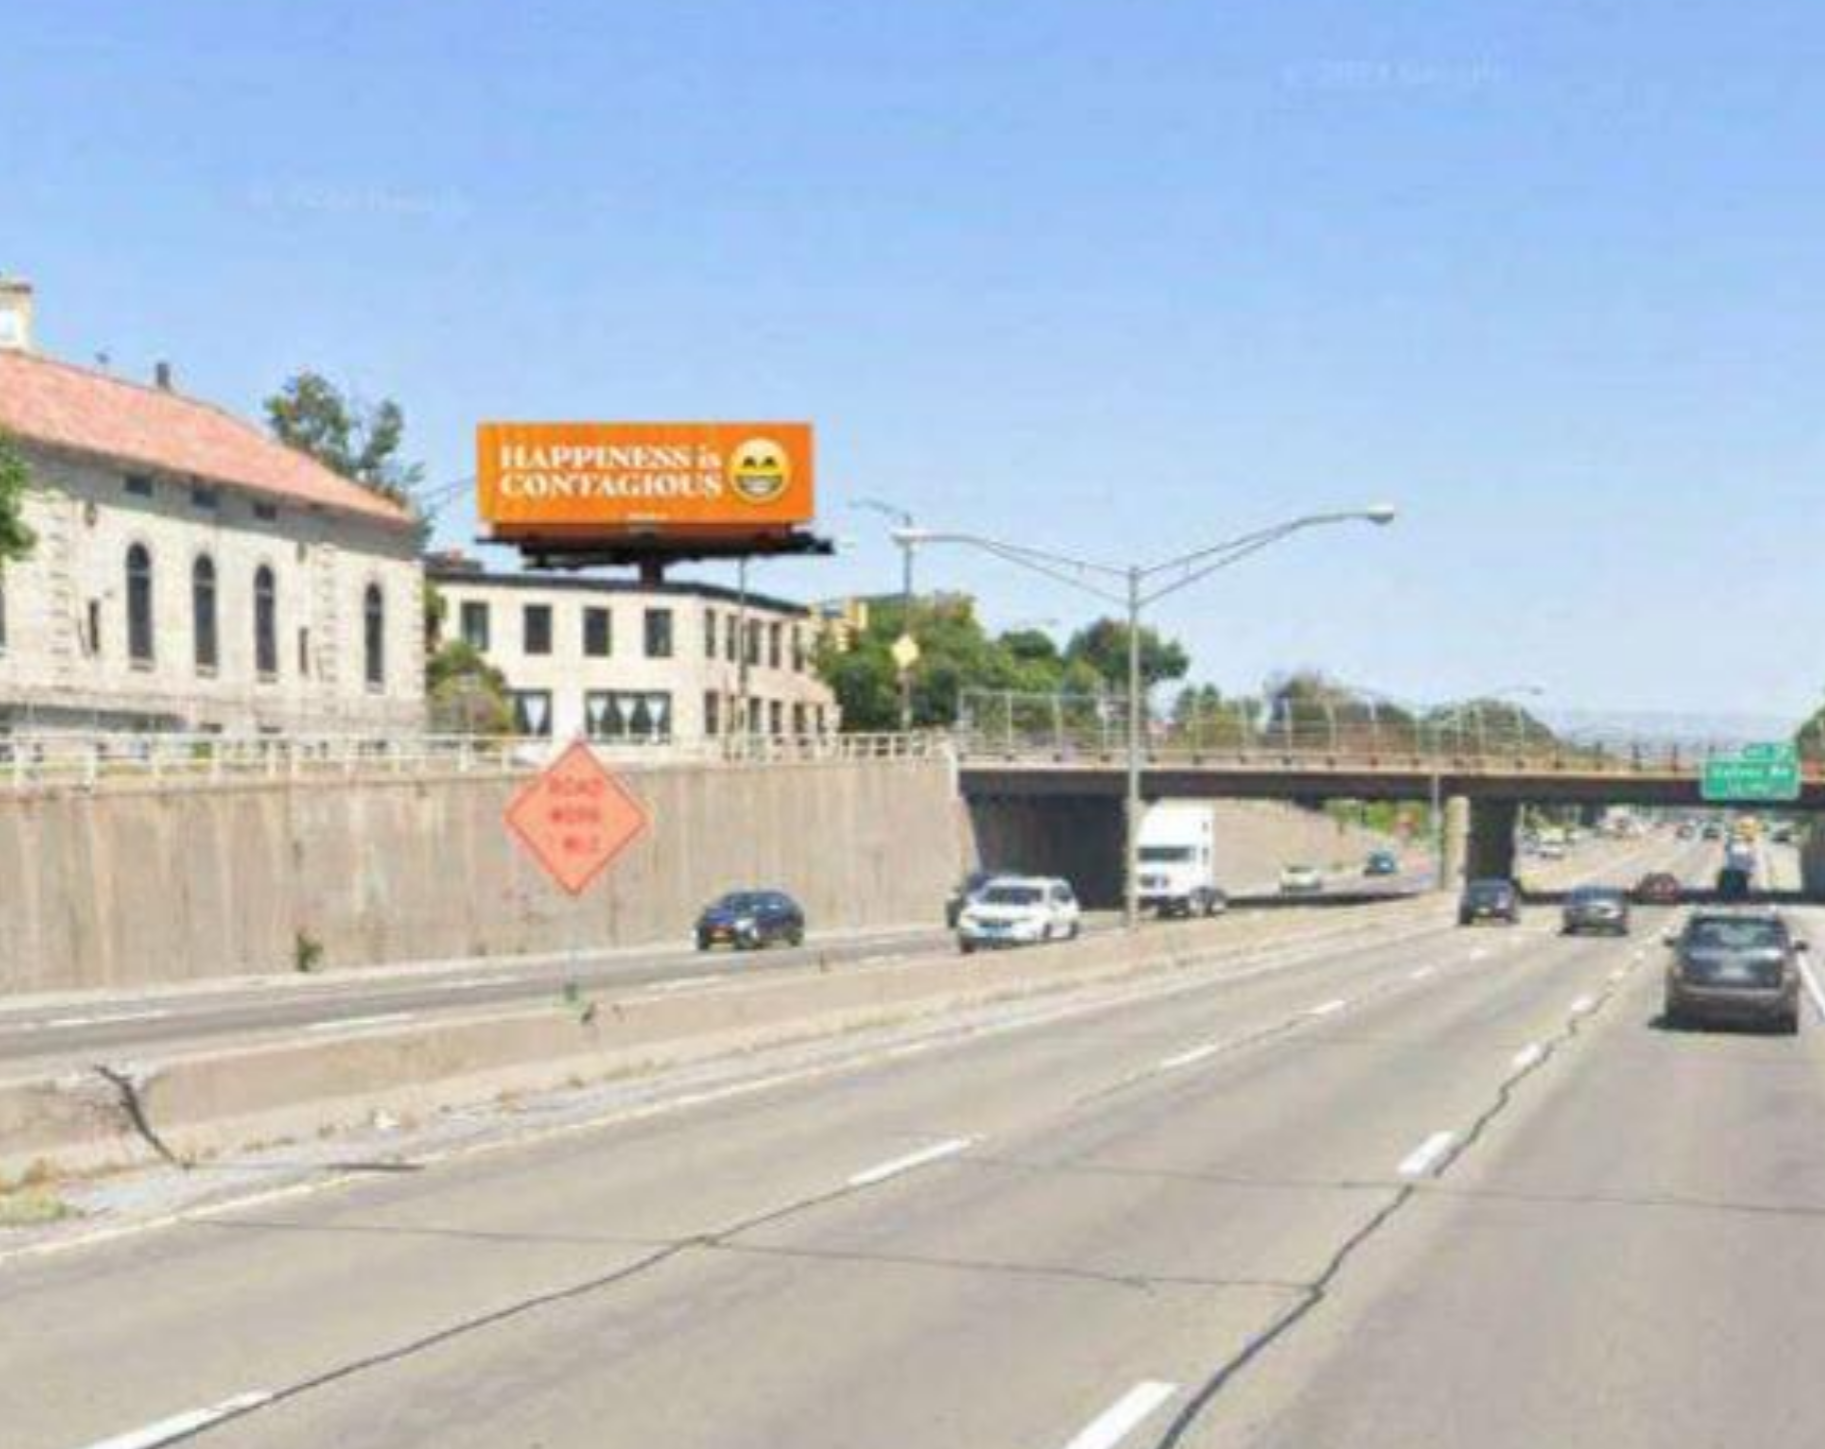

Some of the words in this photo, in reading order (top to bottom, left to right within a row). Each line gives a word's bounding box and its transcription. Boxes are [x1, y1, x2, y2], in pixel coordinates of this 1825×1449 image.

[500, 445, 690, 469] HAPPINESS
[699, 445, 722, 469] is
[499, 472, 723, 498] CONTAGIOUS
